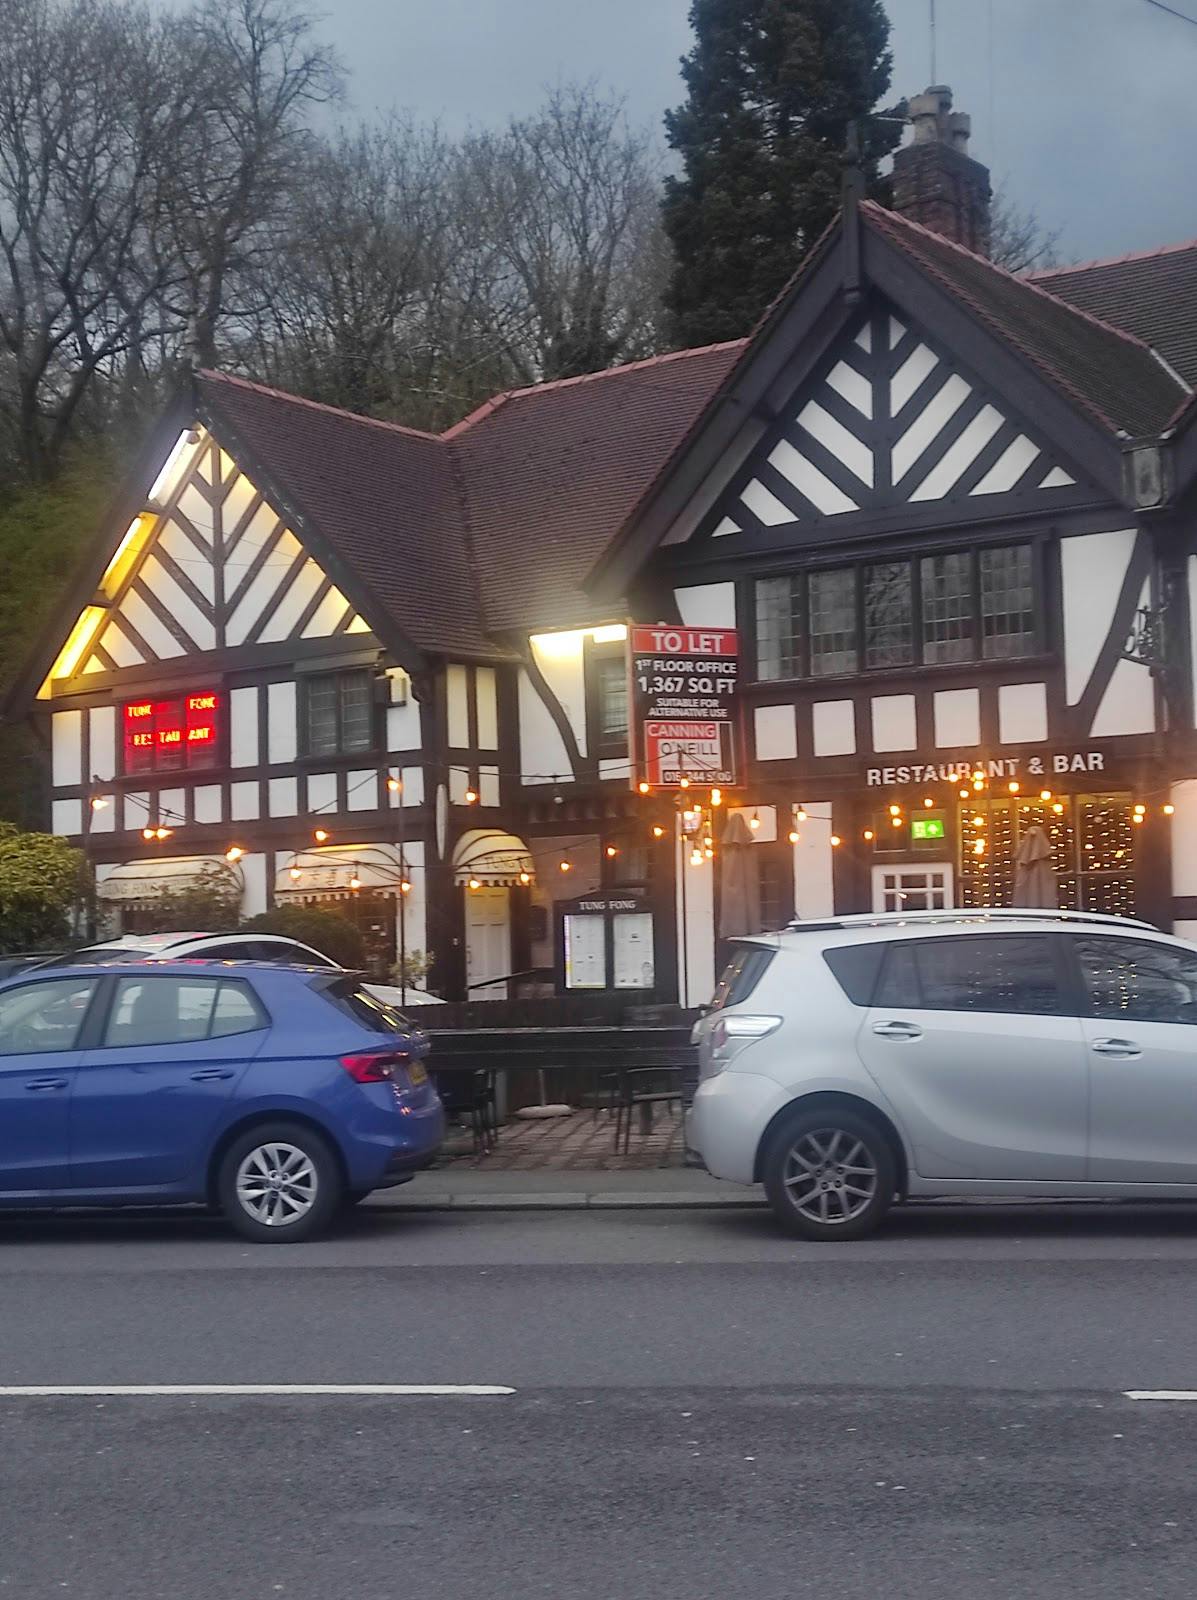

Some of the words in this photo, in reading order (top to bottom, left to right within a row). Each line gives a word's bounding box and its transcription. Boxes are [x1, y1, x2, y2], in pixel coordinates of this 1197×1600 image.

[651, 632, 682, 652] TO
[688, 634, 724, 653] LET
[635, 660, 652, 671] 1ST
[654, 661, 694, 672] FLOOR
[695, 662, 737, 673] OFFICE
[638, 676, 682, 694] 1,367
[688, 677, 713, 693] SQ
[716, 678, 736, 694] FT
[656, 698, 699, 708] SUITABLE
[700, 699, 719, 708] FOR
[648, 708, 709, 717] ALTERNATIVE
[710, 709, 728, 718] USE
[647, 724, 716, 737] CANNING
[1028, 757, 1045, 775] &
[1053, 752, 1105, 773] BAR
[664, 771, 686, 782] 015
[579, 901, 605, 910] TUNG
[609, 900, 636, 909] FONG
